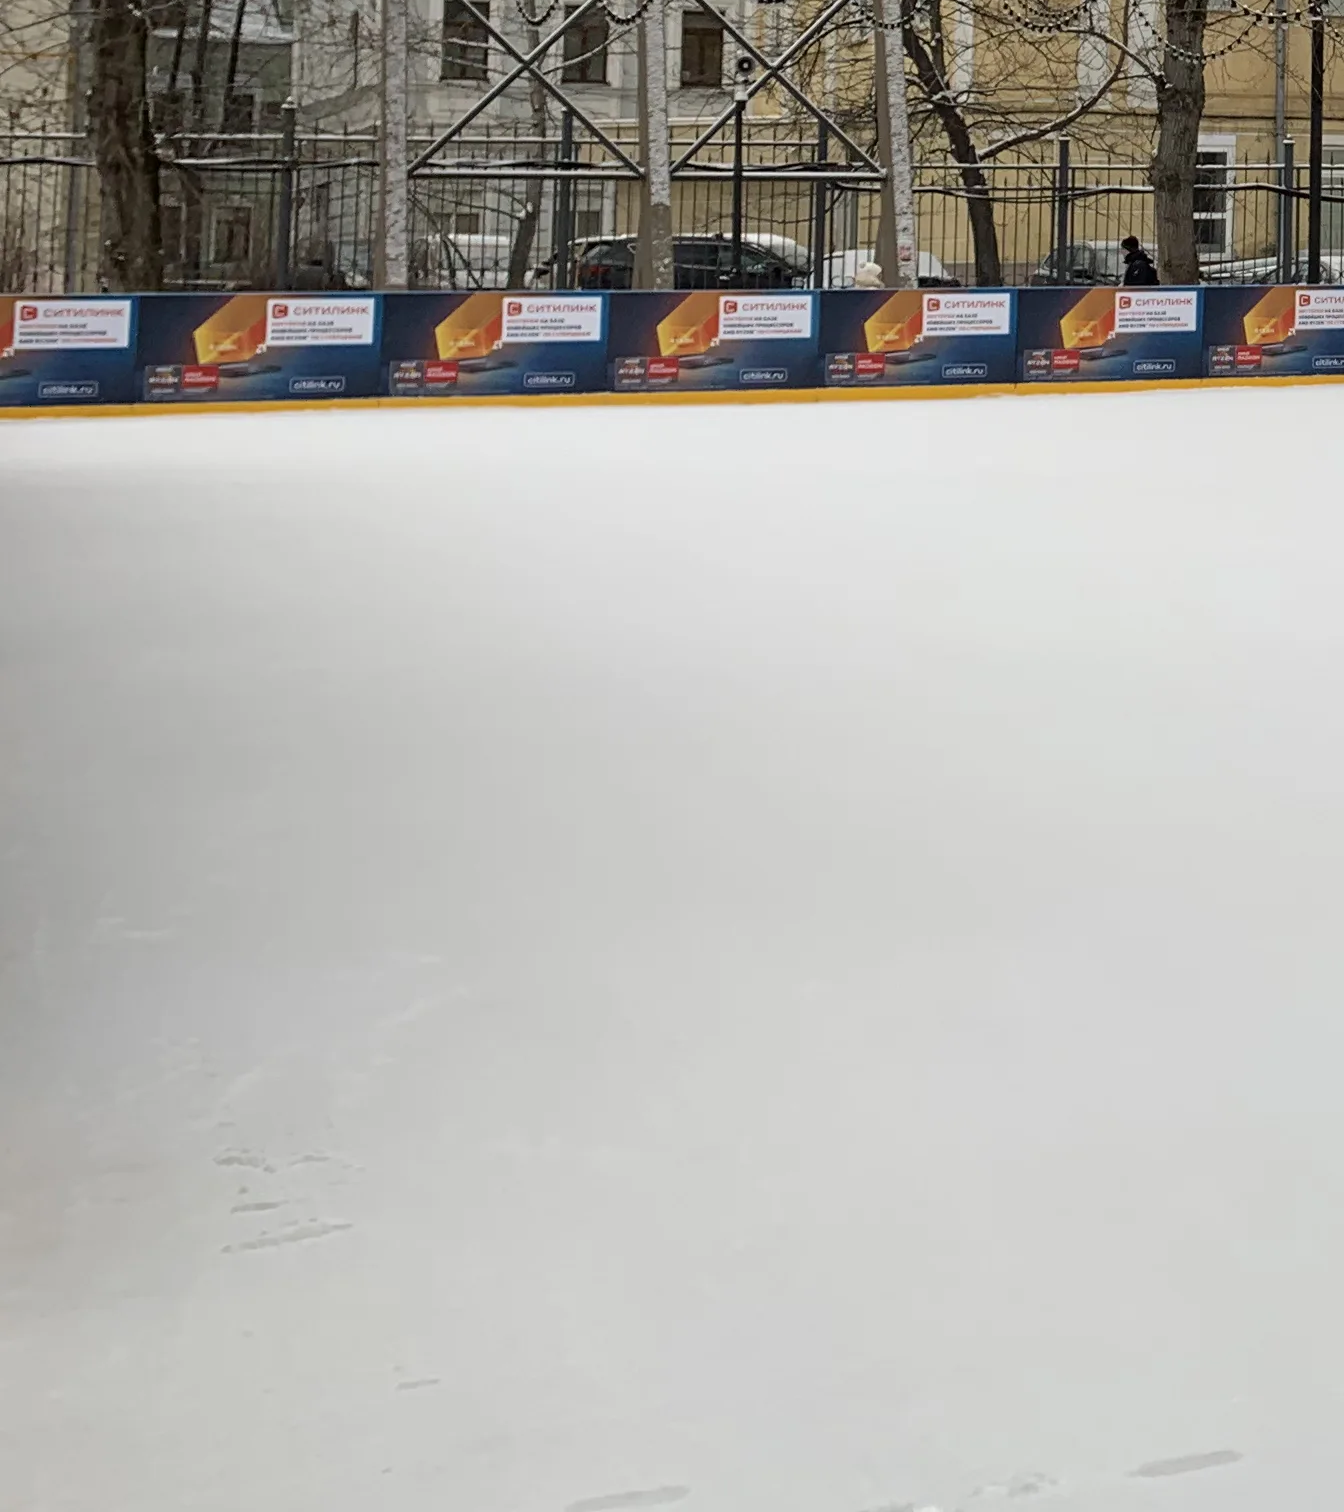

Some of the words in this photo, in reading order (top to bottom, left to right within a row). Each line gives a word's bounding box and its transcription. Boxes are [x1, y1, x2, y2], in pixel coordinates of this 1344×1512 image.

[742, 302, 807, 311] СИТИЛИНК
[944, 300, 1006, 309] СИТИЛИНК
[1135, 298, 1193, 306] СИТИЛИНК
[527, 304, 597, 313] СИТИЛИНК
